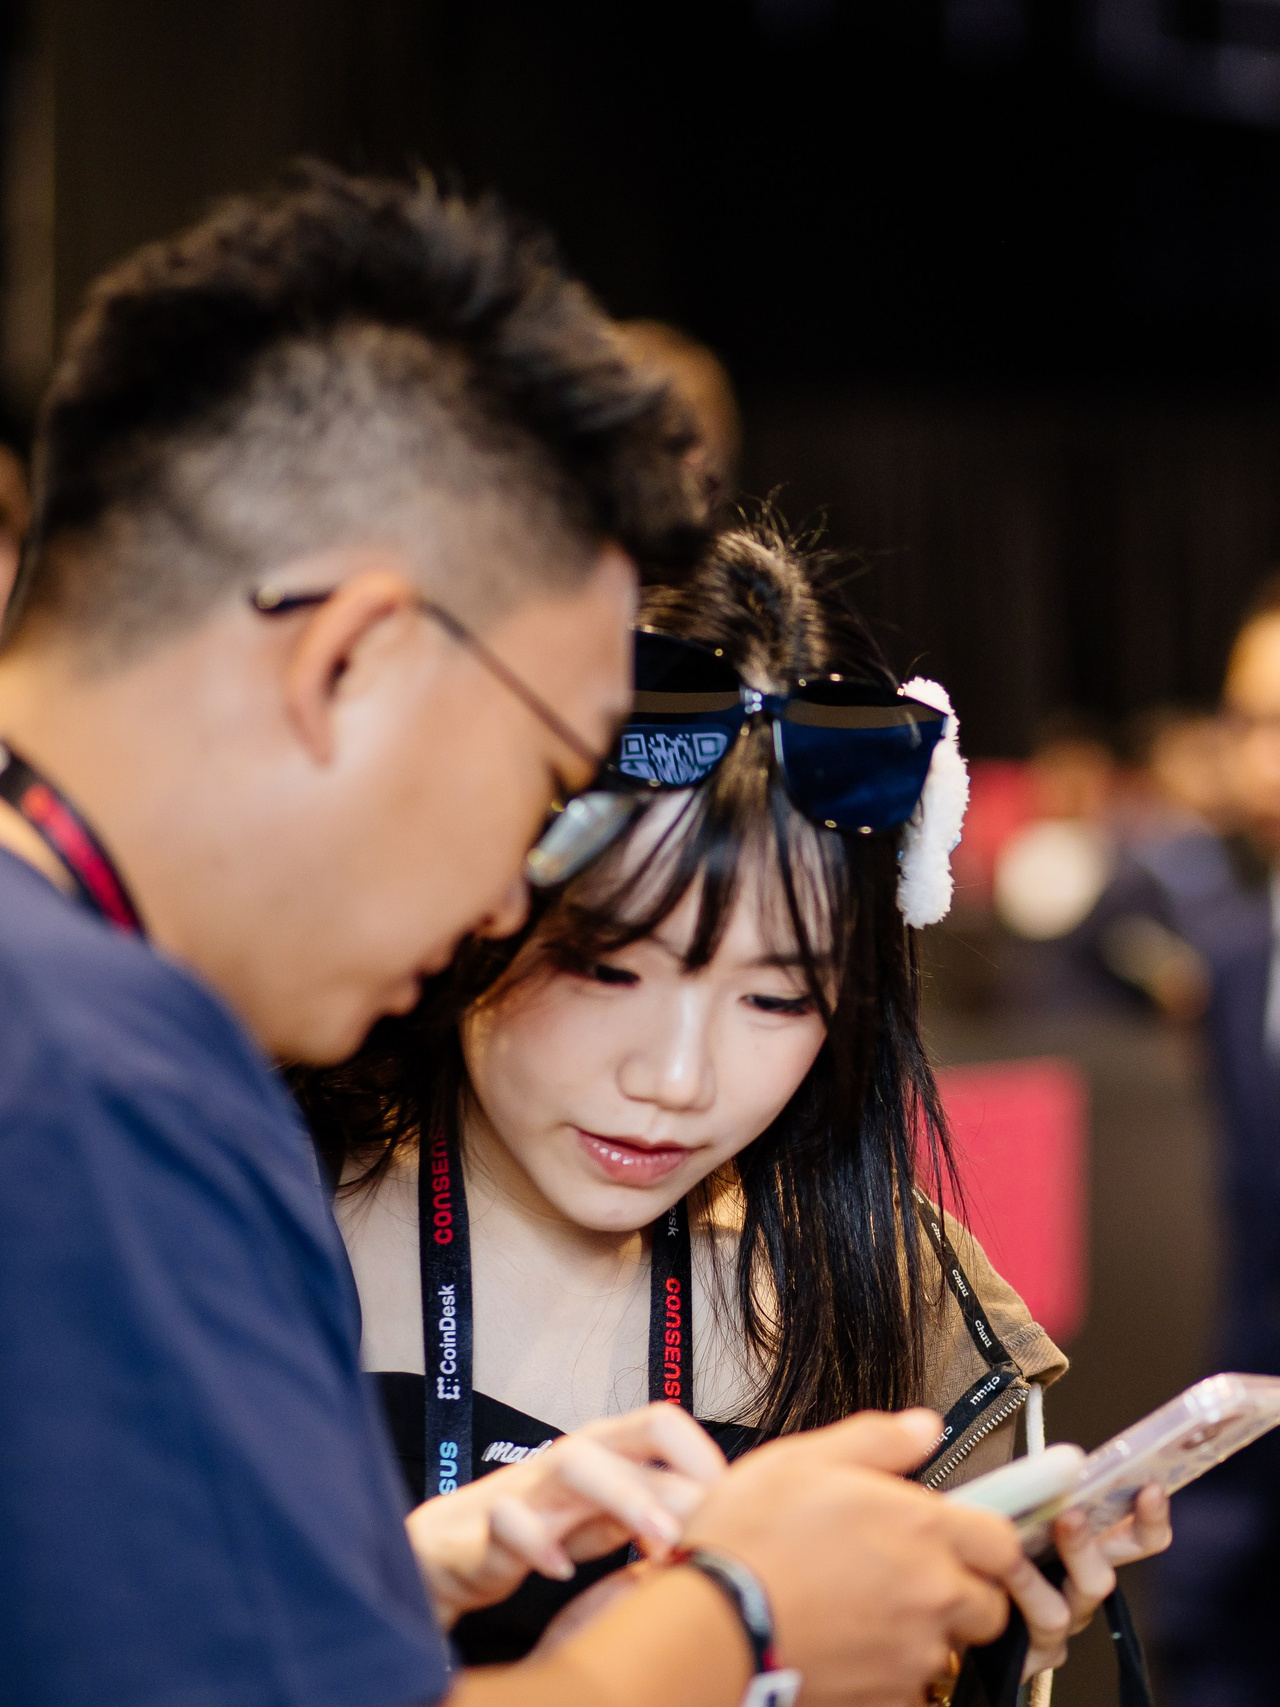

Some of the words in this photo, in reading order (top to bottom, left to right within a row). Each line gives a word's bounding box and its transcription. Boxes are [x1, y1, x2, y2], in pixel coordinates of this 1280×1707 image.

[952, 1269, 969, 1297] chuu
[438, 1284, 456, 1375] CoinDesk
[975, 1319, 993, 1348] chuu
[970, 1375, 1000, 1406] chuu
